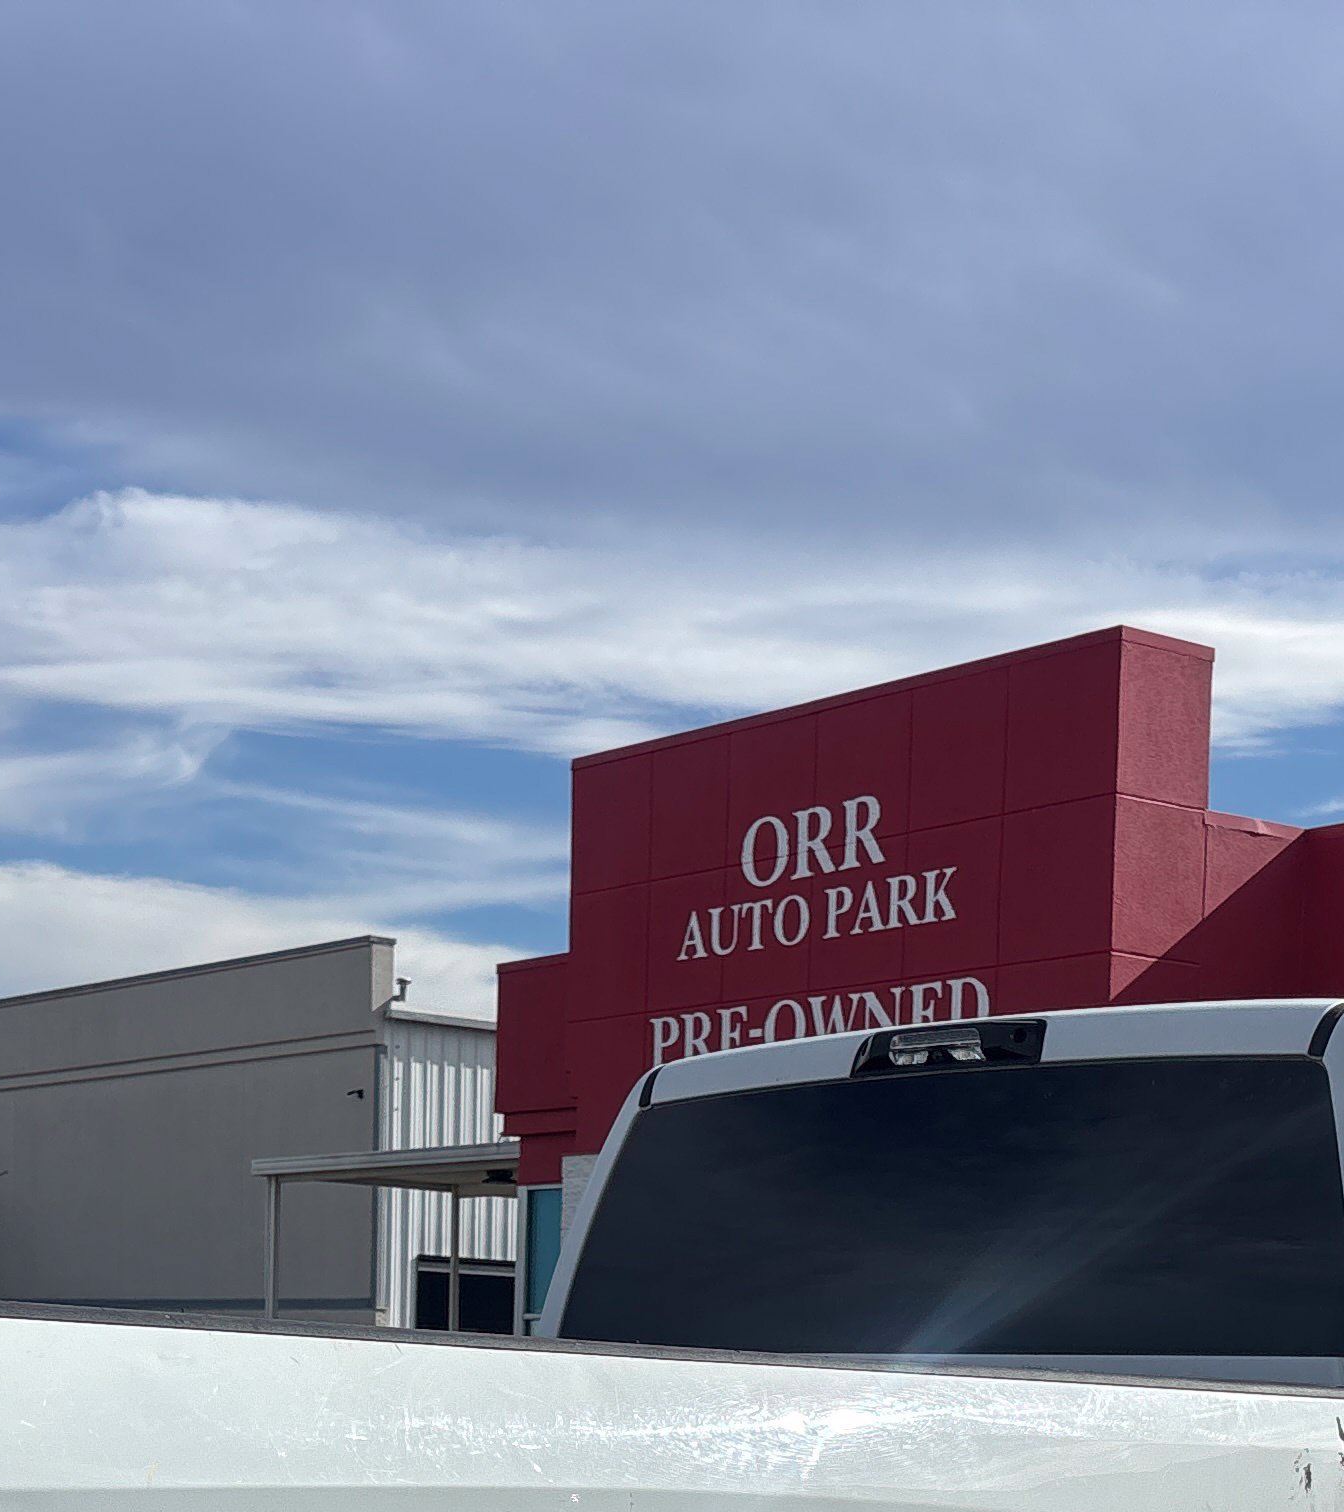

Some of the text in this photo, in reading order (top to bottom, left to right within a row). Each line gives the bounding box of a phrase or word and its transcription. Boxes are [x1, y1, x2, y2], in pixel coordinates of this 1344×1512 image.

[741, 795, 886, 888] ORR
[676, 865, 959, 962] AUTO PARK
[650, 976, 991, 1069] PRE-OWNED
